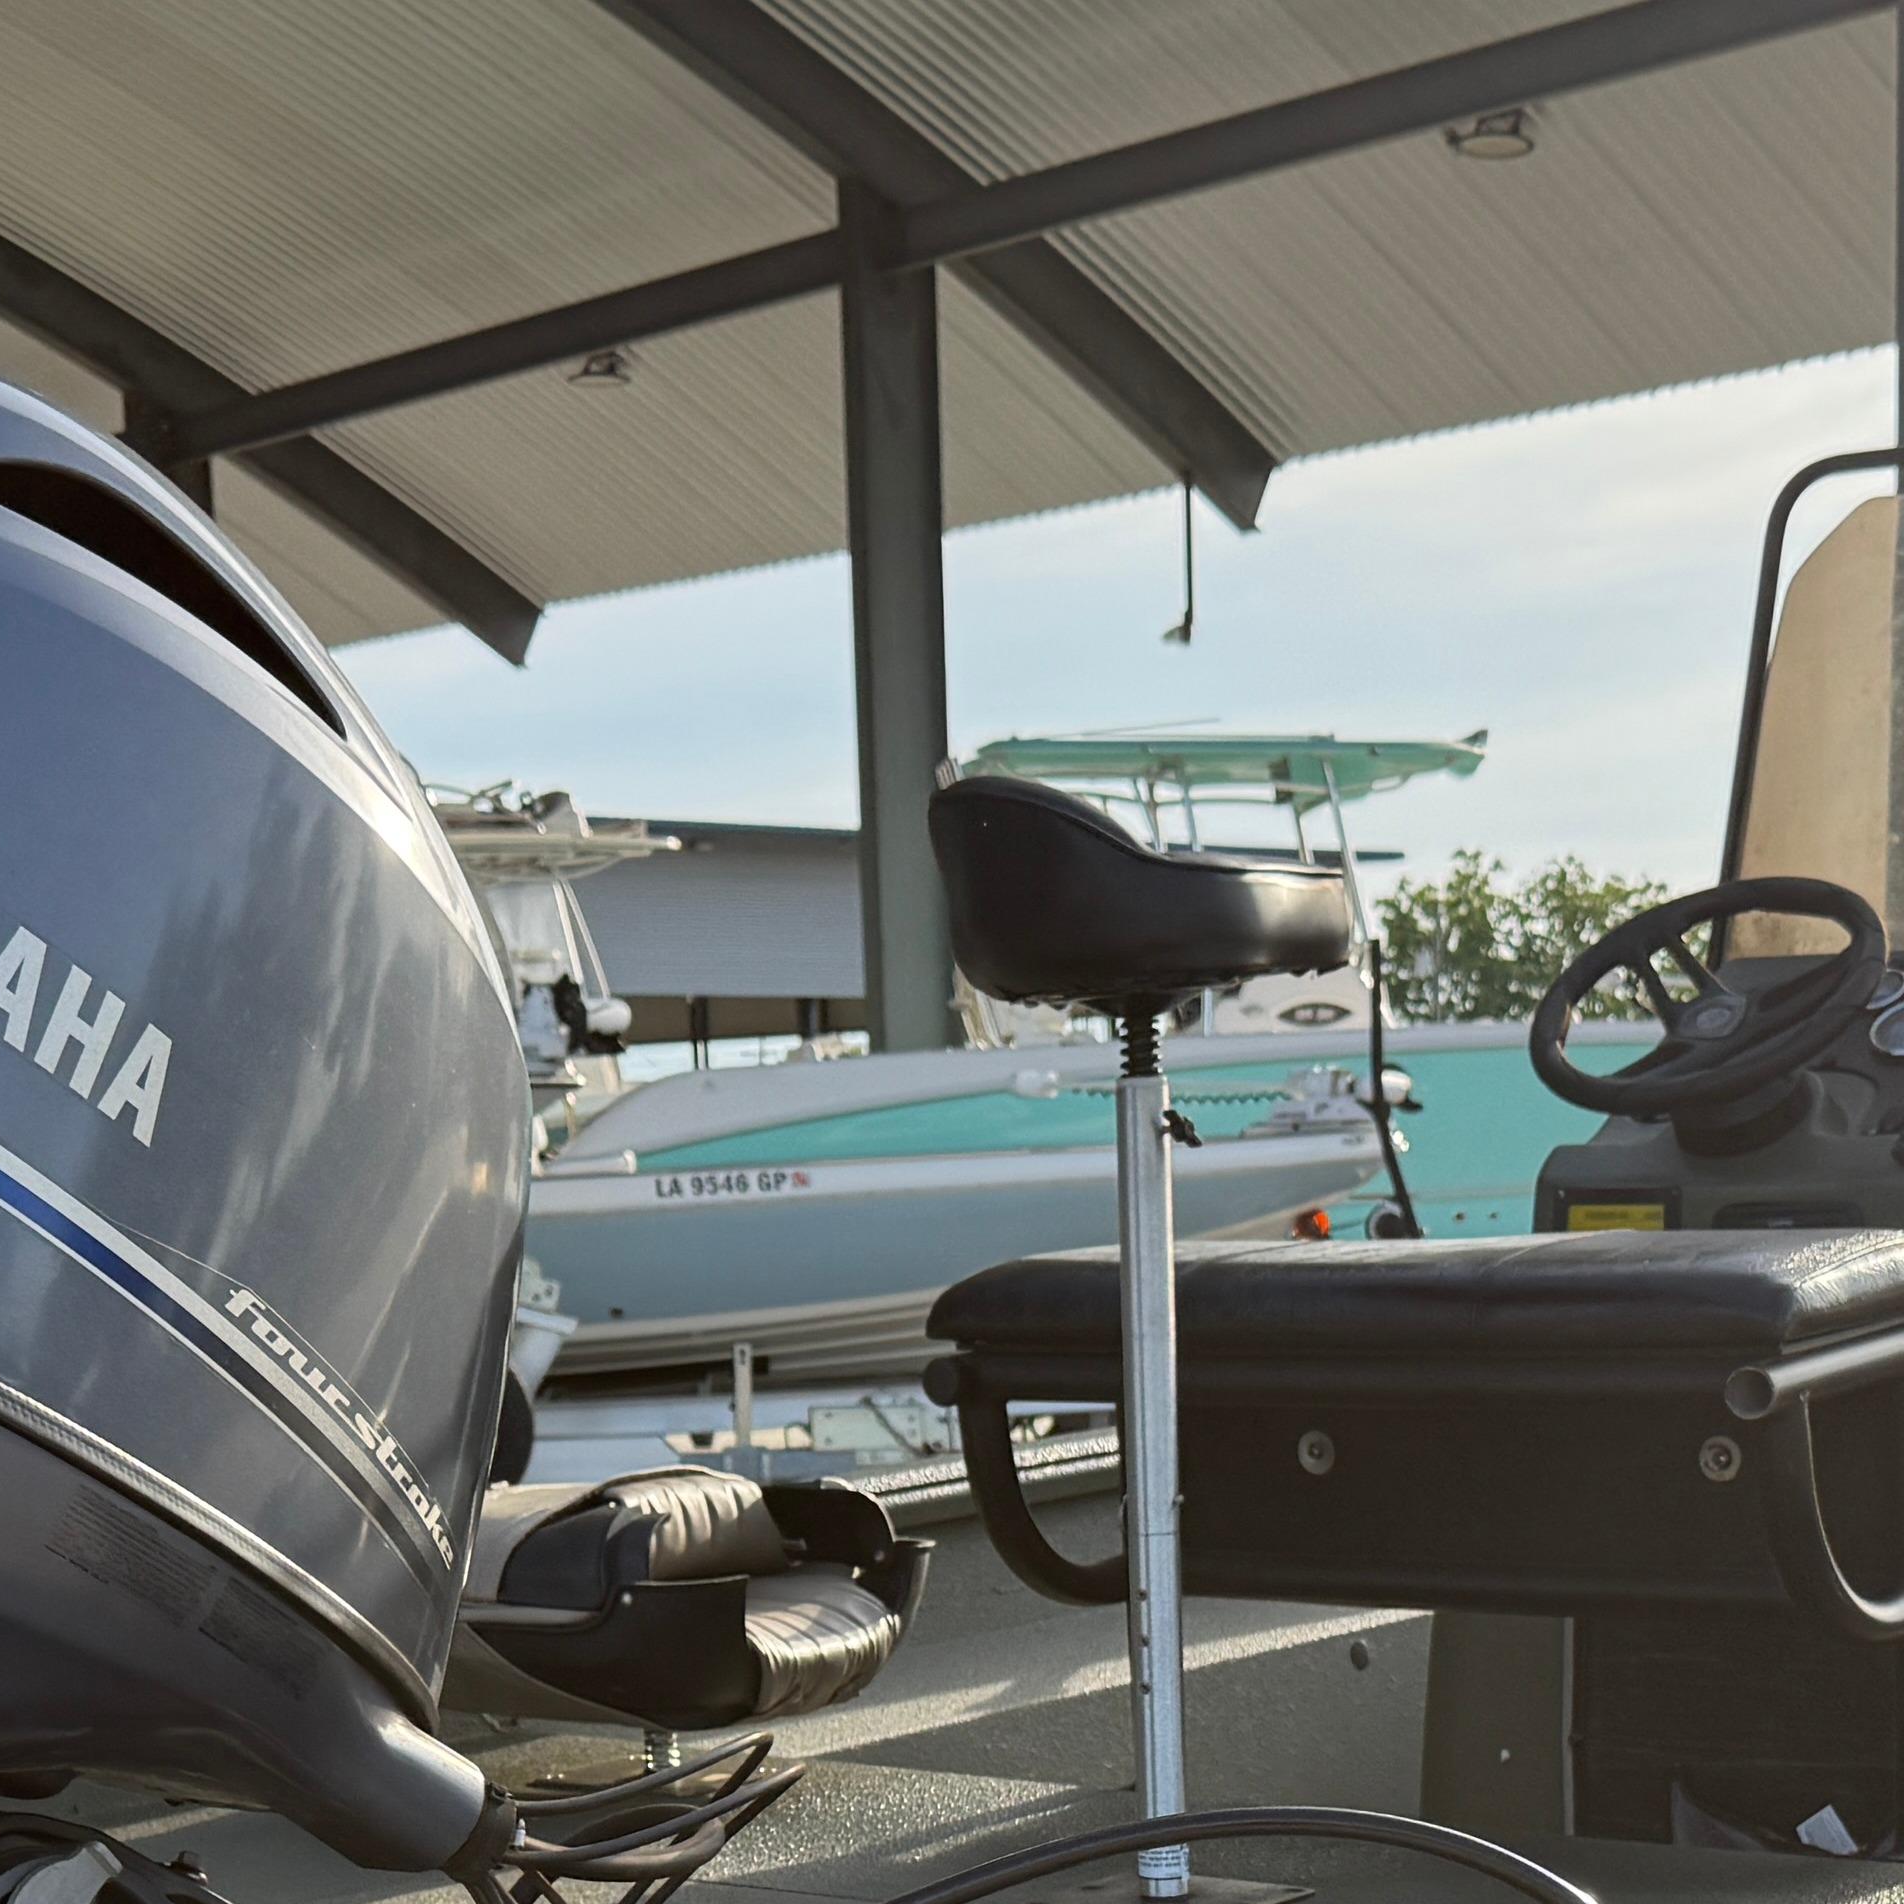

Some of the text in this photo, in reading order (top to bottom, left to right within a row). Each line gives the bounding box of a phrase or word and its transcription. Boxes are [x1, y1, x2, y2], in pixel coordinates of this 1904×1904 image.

[655, 1176, 683, 1199] LA
[690, 1173, 750, 1197] 9546
[757, 1171, 787, 1192] GP
